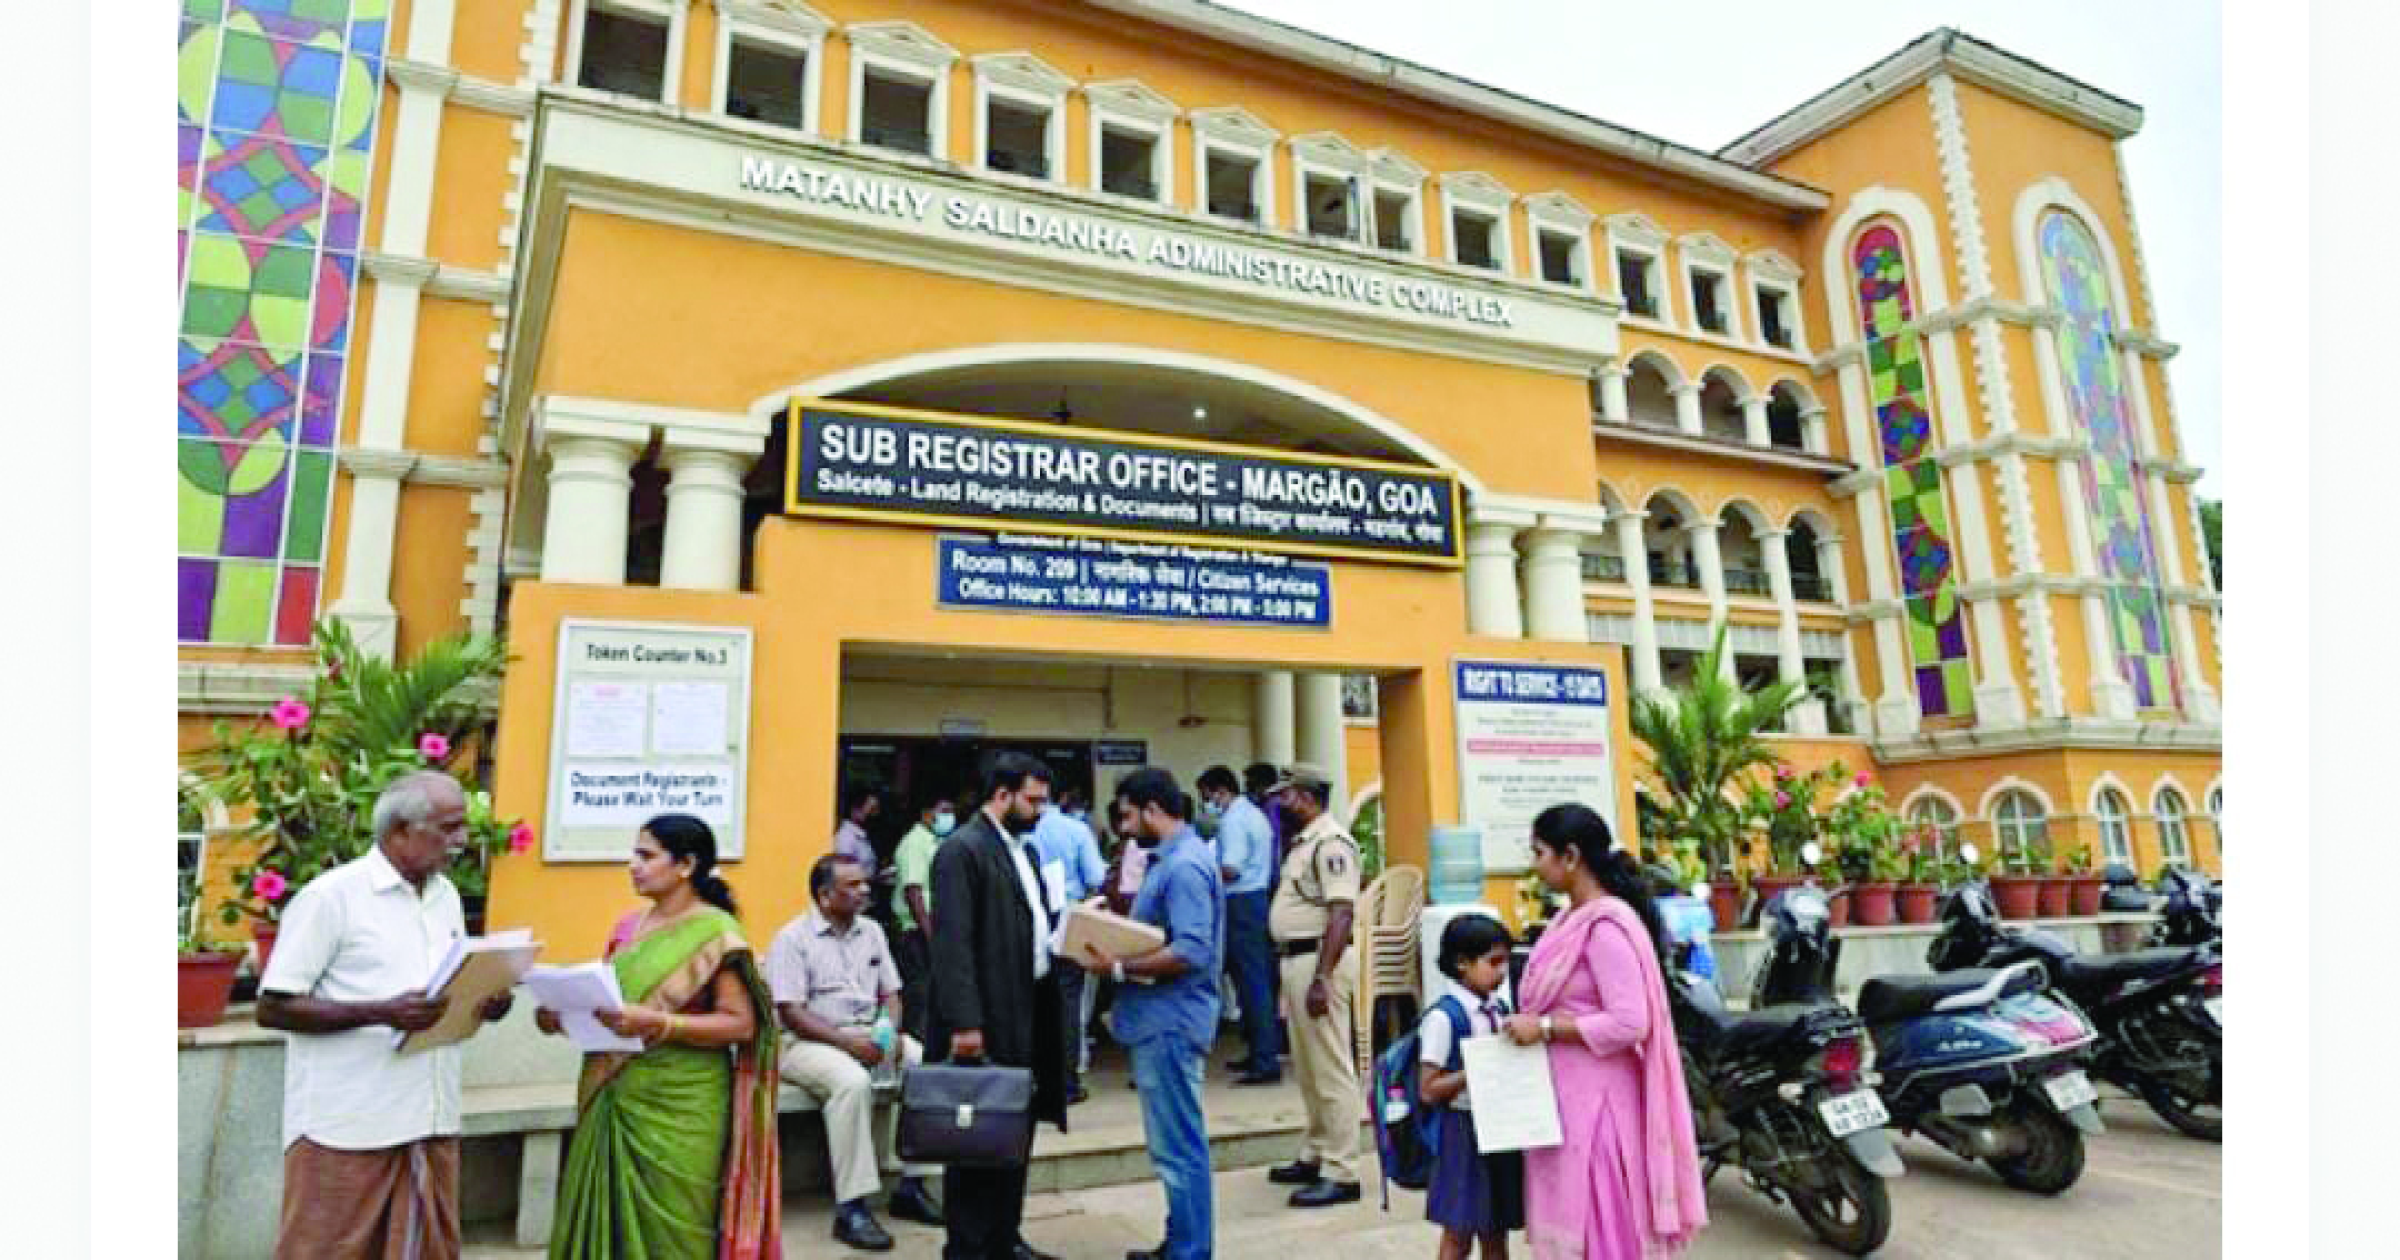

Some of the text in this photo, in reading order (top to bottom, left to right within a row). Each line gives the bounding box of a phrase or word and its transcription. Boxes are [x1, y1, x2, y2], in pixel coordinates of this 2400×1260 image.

[740, 156, 1512, 328] MATANHY SALDANHA ADMINISTRATIVE COMPLEX
[820, 423, 896, 465] SUB
[908, 432, 1100, 485] REGISTRAR
[1109, 453, 1218, 496] OFFICE
[1379, 482, 1438, 516] GOA
[911, 478, 961, 501] Land
[966, 481, 1078, 511] Registration
[1101, 494, 1198, 522] Documents
[952, 549, 1007, 575] Room
[1011, 555, 1041, 578] No.
[958, 577, 1005, 600] Office
[1255, 572, 1320, 597] Services
[587, 643, 629, 661] Token
[632, 644, 690, 662] Counter
[573, 790, 620, 806] Please
